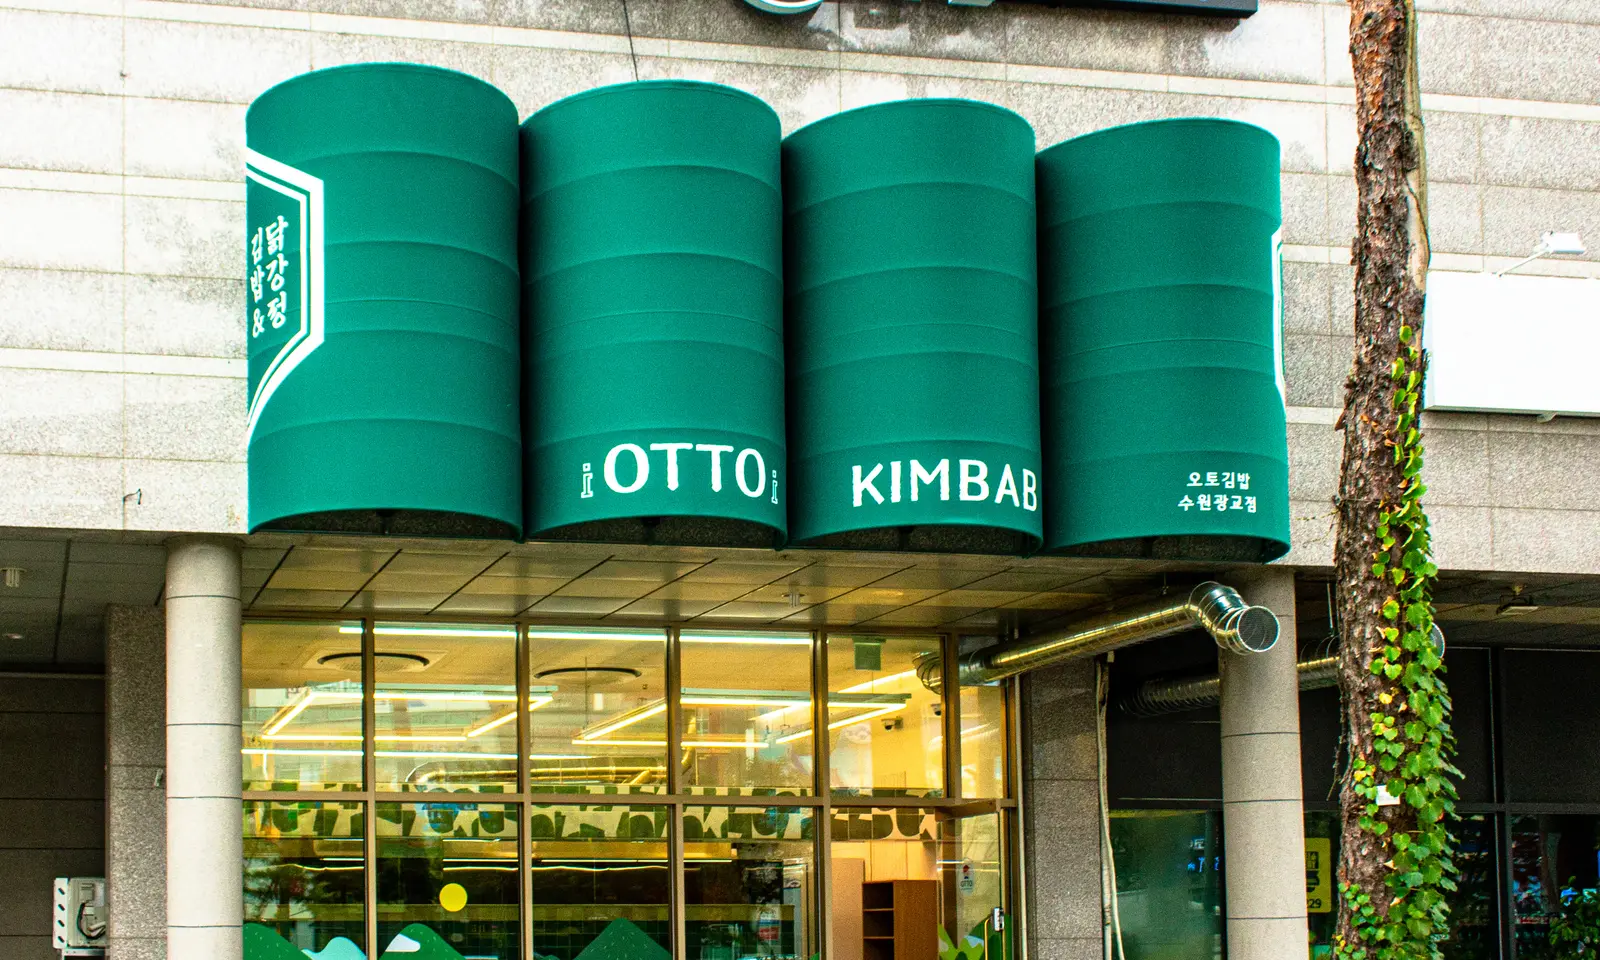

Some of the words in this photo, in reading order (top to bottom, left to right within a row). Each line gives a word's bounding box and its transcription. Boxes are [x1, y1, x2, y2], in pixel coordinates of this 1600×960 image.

[265, 215, 289, 329] 닭강정
[603, 442, 766, 498] OTTO
[852, 458, 1037, 512] KIMBAB
[1186, 471, 1251, 490] 오토김밥
[1177, 493, 1257, 514] 수원광교점
